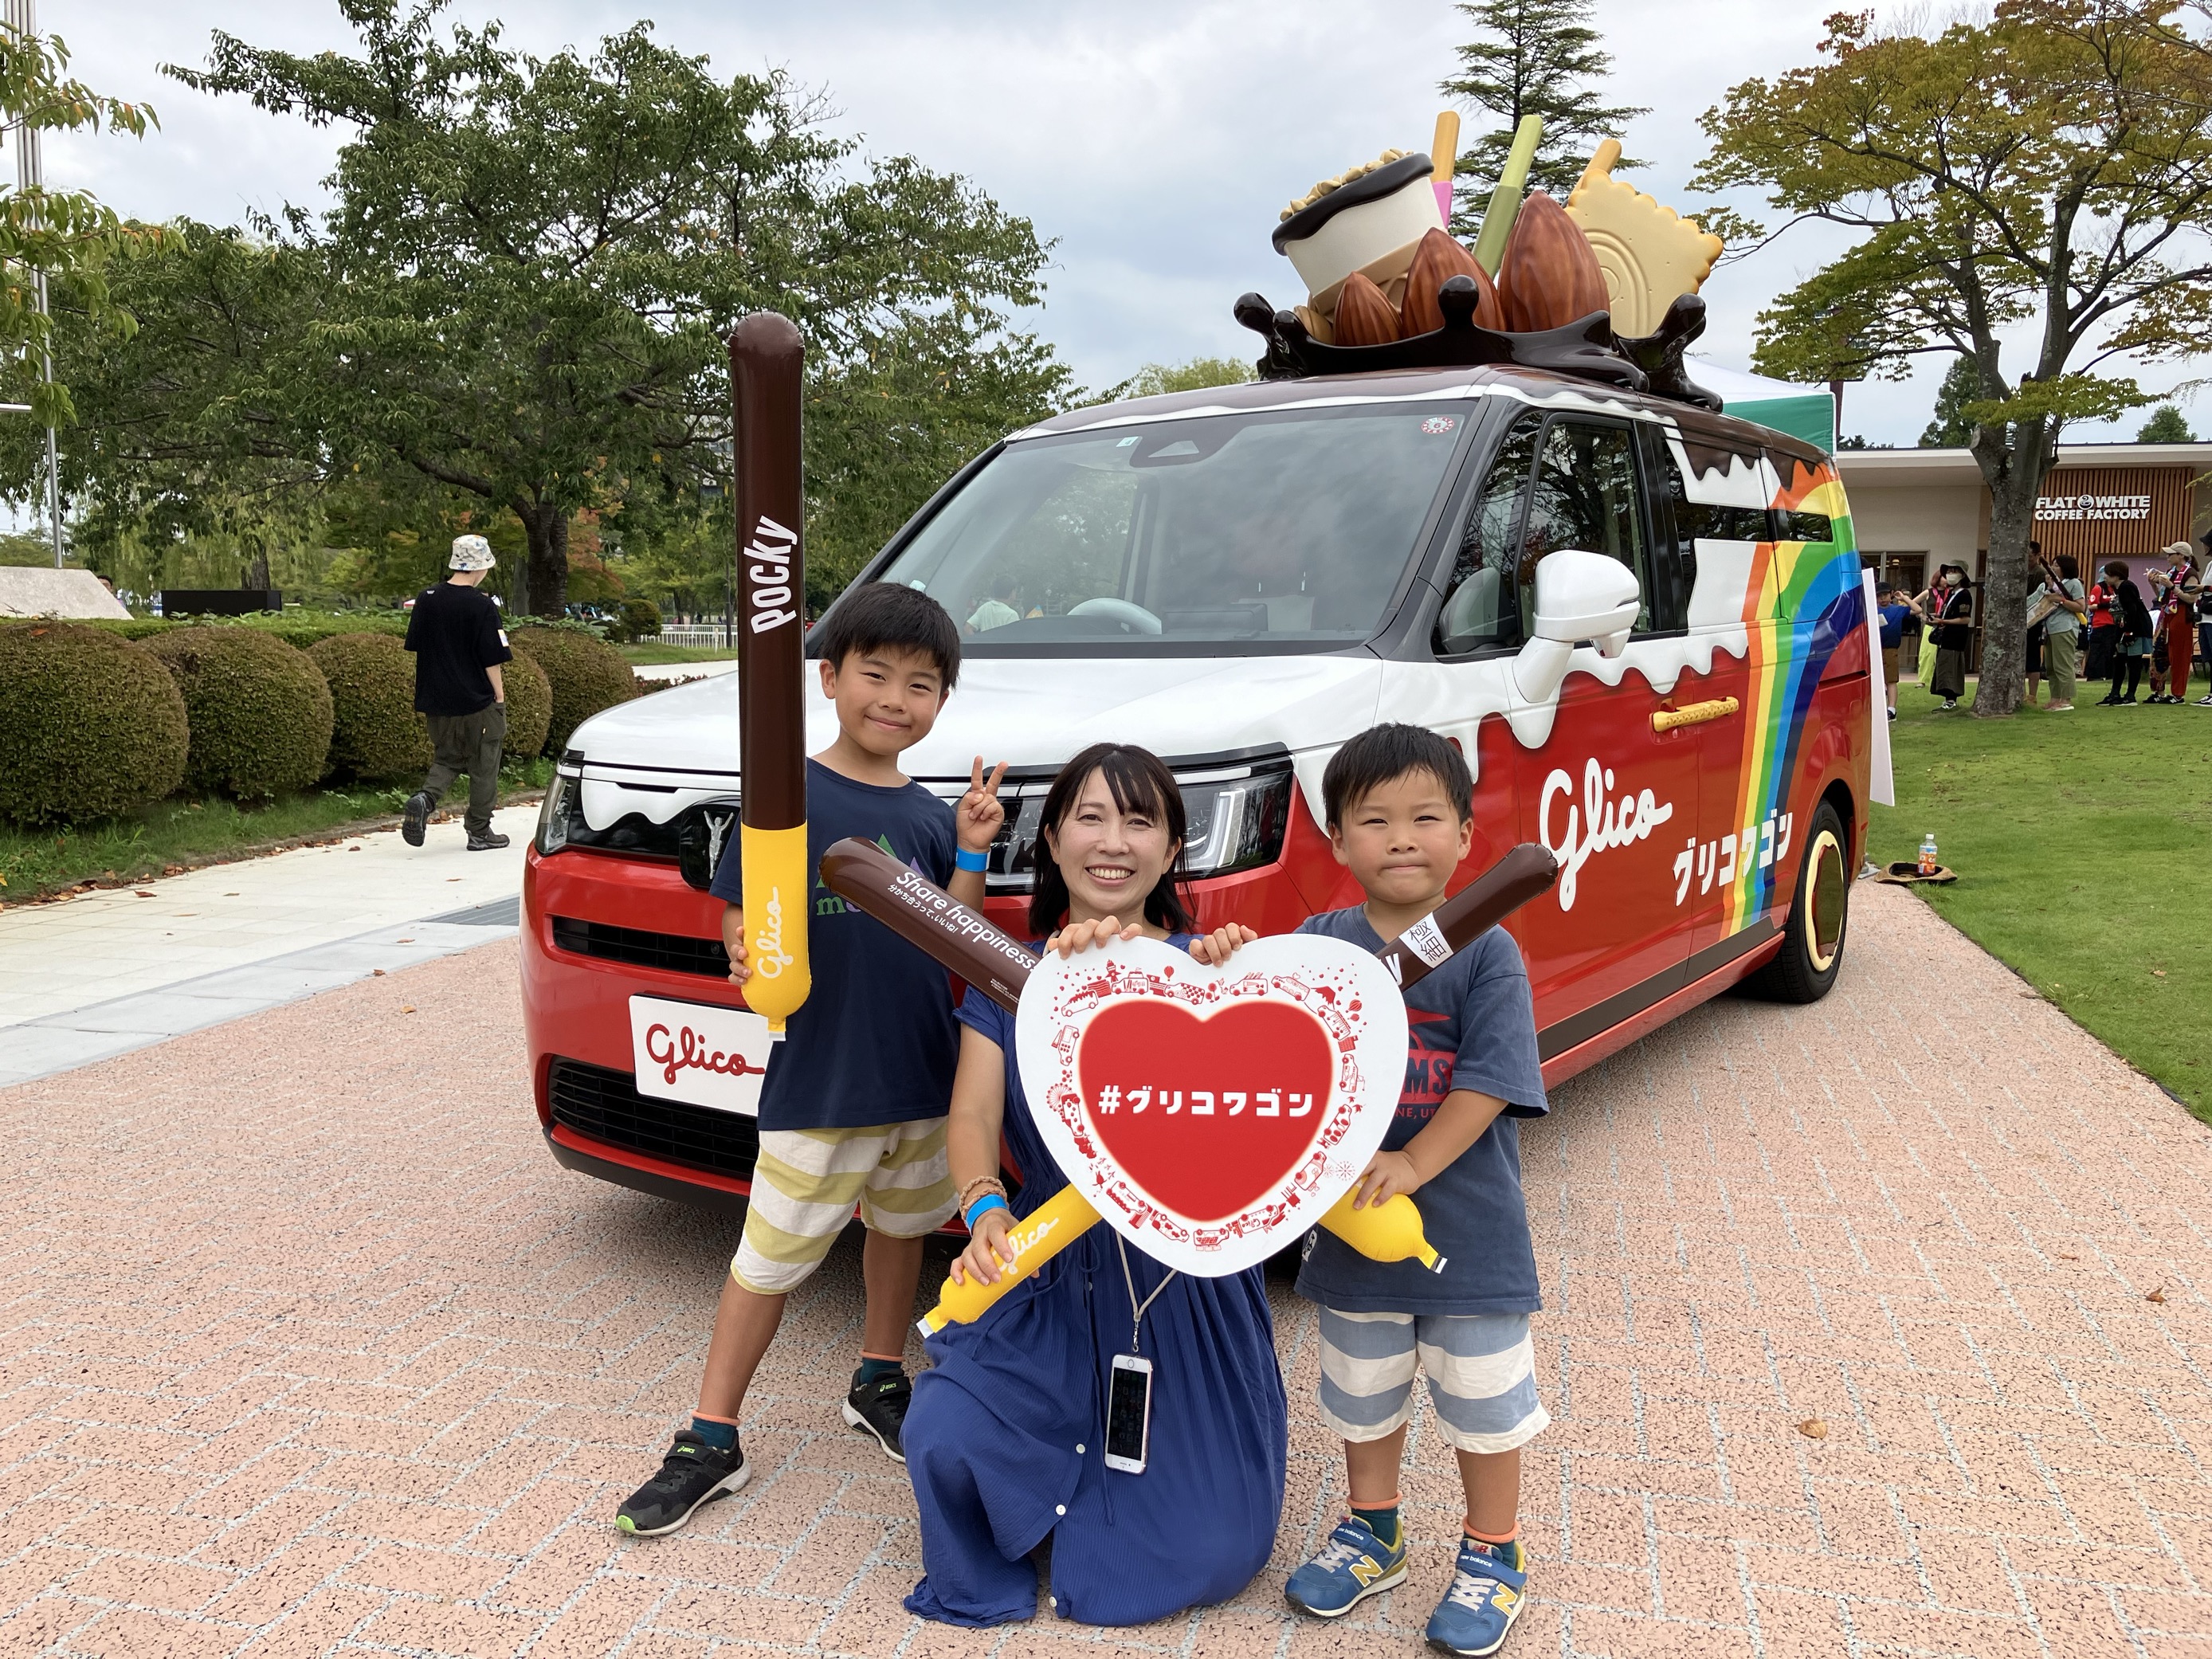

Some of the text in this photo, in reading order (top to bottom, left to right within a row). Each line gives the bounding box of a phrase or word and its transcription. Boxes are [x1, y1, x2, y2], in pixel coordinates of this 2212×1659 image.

[2034, 508, 2151, 520] COFFEE FACTORY
[2035, 495, 2151, 509] FLAT WHITE
[1539, 757, 1673, 912] Glico
[1673, 807, 1793, 907] グリコワゴン
[756, 886, 794, 979] Glico
[896, 872, 1036, 972] Share happiness
[1406, 919, 1447, 962] 極細
[645, 1023, 766, 1085] Glico
[1098, 1084, 1313, 1117] #グリコワゴン
